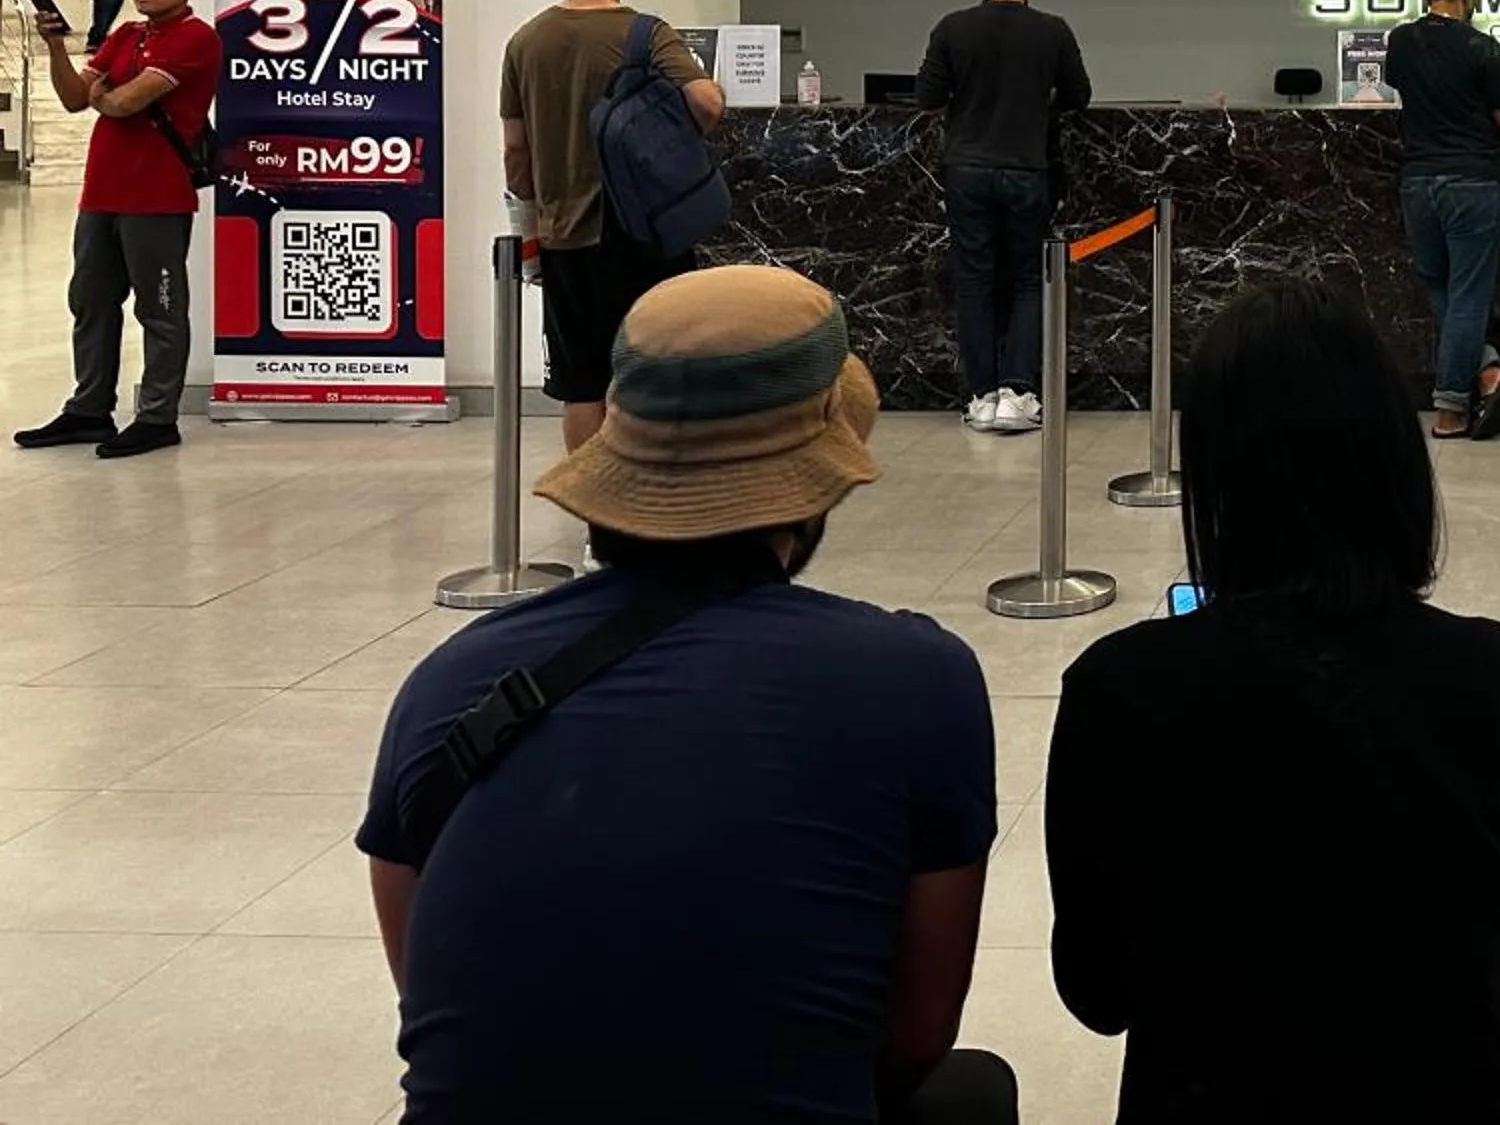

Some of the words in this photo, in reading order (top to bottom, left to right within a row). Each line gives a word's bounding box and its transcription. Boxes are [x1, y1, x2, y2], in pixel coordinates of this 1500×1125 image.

[229, 58, 307, 81] DAYS
[338, 58, 429, 81] NIGHT
[277, 91, 327, 106] Hotel
[332, 91, 376, 109] Stay
[248, 140, 271, 152] For
[256, 153, 287, 167] only
[256, 362, 305, 374] SCAN
[306, 362, 332, 374] TO
[335, 363, 410, 374] REDEEM
